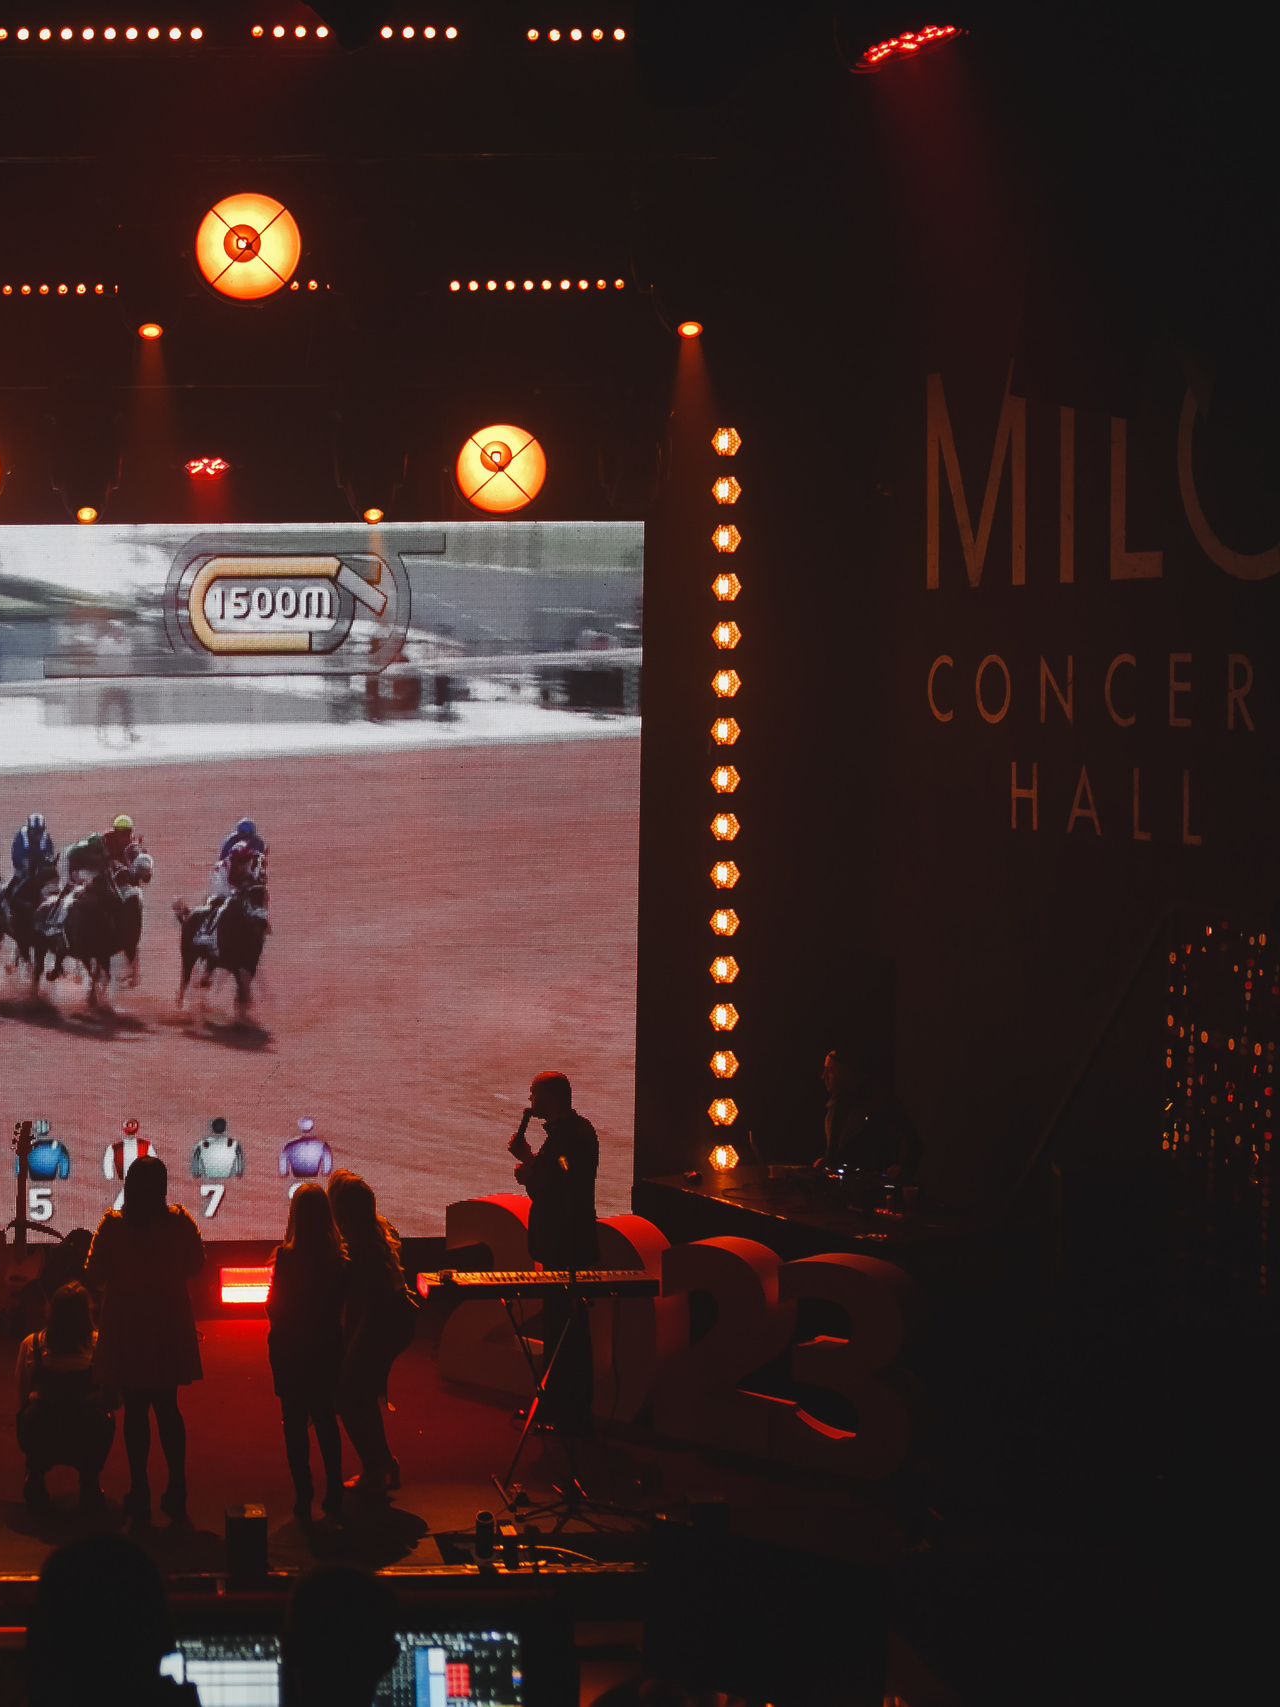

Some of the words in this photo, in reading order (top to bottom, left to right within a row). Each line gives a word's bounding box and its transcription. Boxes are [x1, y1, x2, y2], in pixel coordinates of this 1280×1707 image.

[926, 652, 1255, 732] CONCER
[1010, 761, 1202, 846] HALL
[29, 1187, 54, 1221] 5
[200, 1184, 226, 1218] 7
